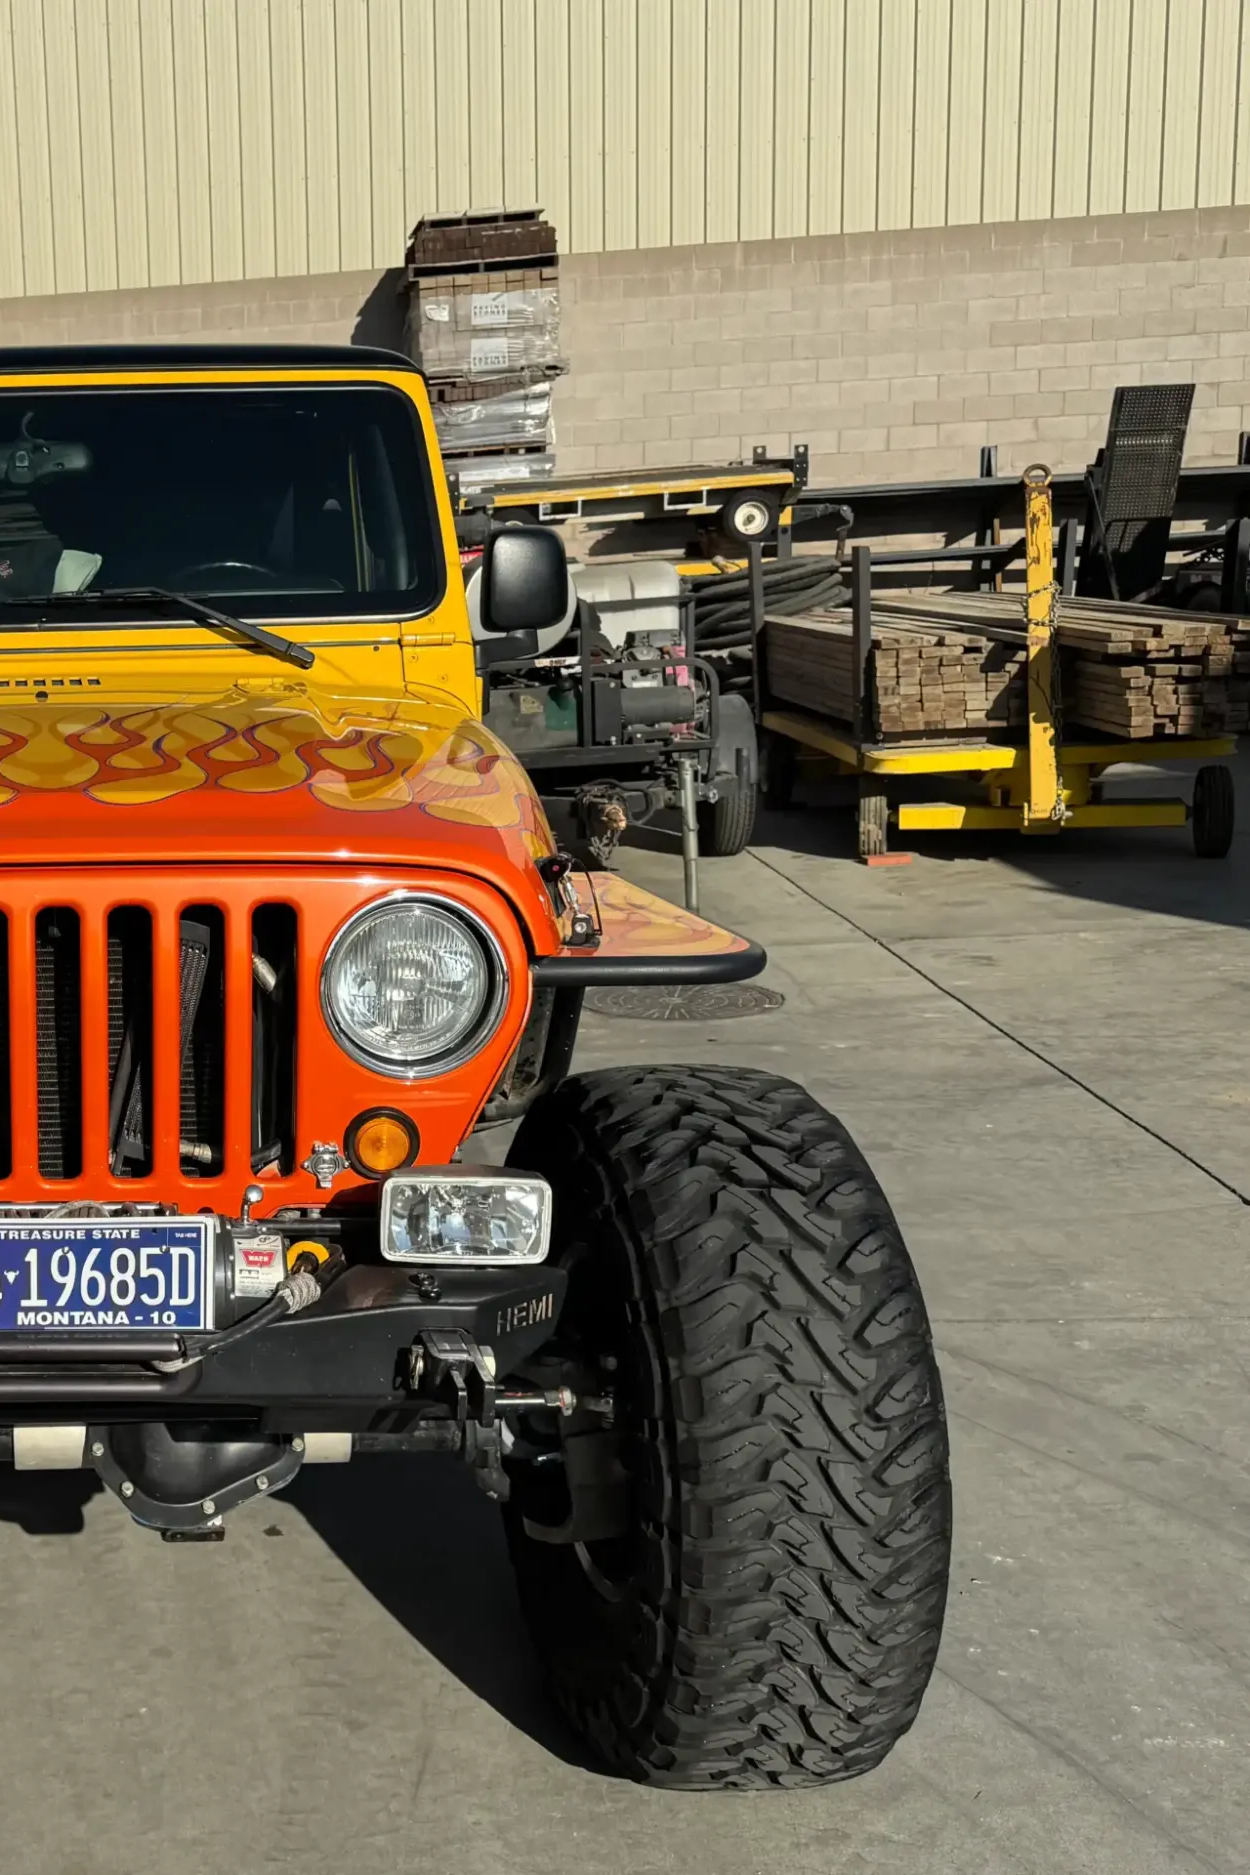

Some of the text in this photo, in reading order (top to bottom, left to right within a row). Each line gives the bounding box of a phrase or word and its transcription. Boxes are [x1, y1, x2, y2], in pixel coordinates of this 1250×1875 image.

[92, 1228, 141, 1239] STATE
[20, 1246, 196, 1307] 19685D
[16, 1310, 129, 1326] MONTANA
[153, 1310, 177, 1325] 10
[496, 1293, 553, 1337] HEMI
